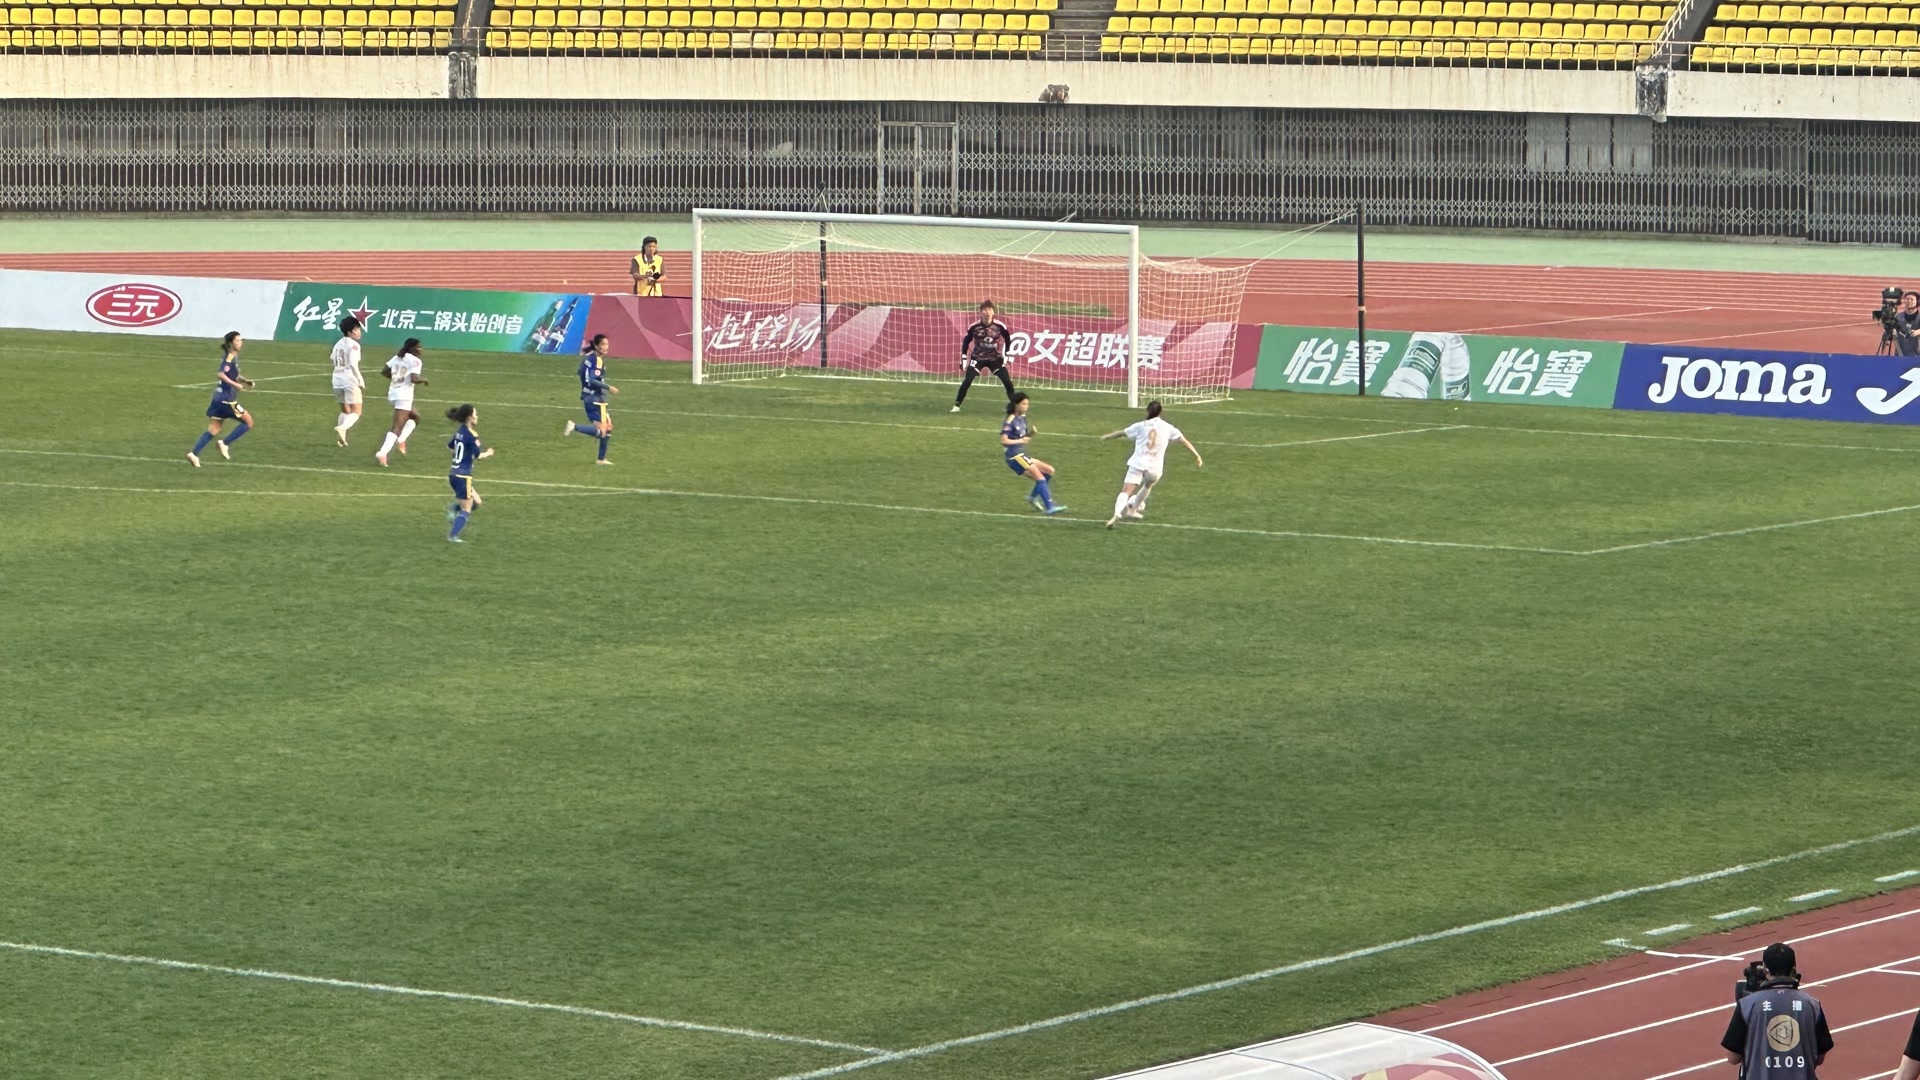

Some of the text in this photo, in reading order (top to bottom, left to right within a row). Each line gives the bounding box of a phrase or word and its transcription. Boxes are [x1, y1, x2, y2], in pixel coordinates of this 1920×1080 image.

[107, 293, 160, 317] 三元
[293, 295, 524, 335] 红星 北京二锅头始创者
[1003, 329, 1165, 370] @女超联赛
[1283, 337, 1390, 387] 怡寶
[1483, 347, 1593, 398] 怡寶
[1647, 356, 1832, 405] Joma
[1146, 428, 1157, 450] 9
